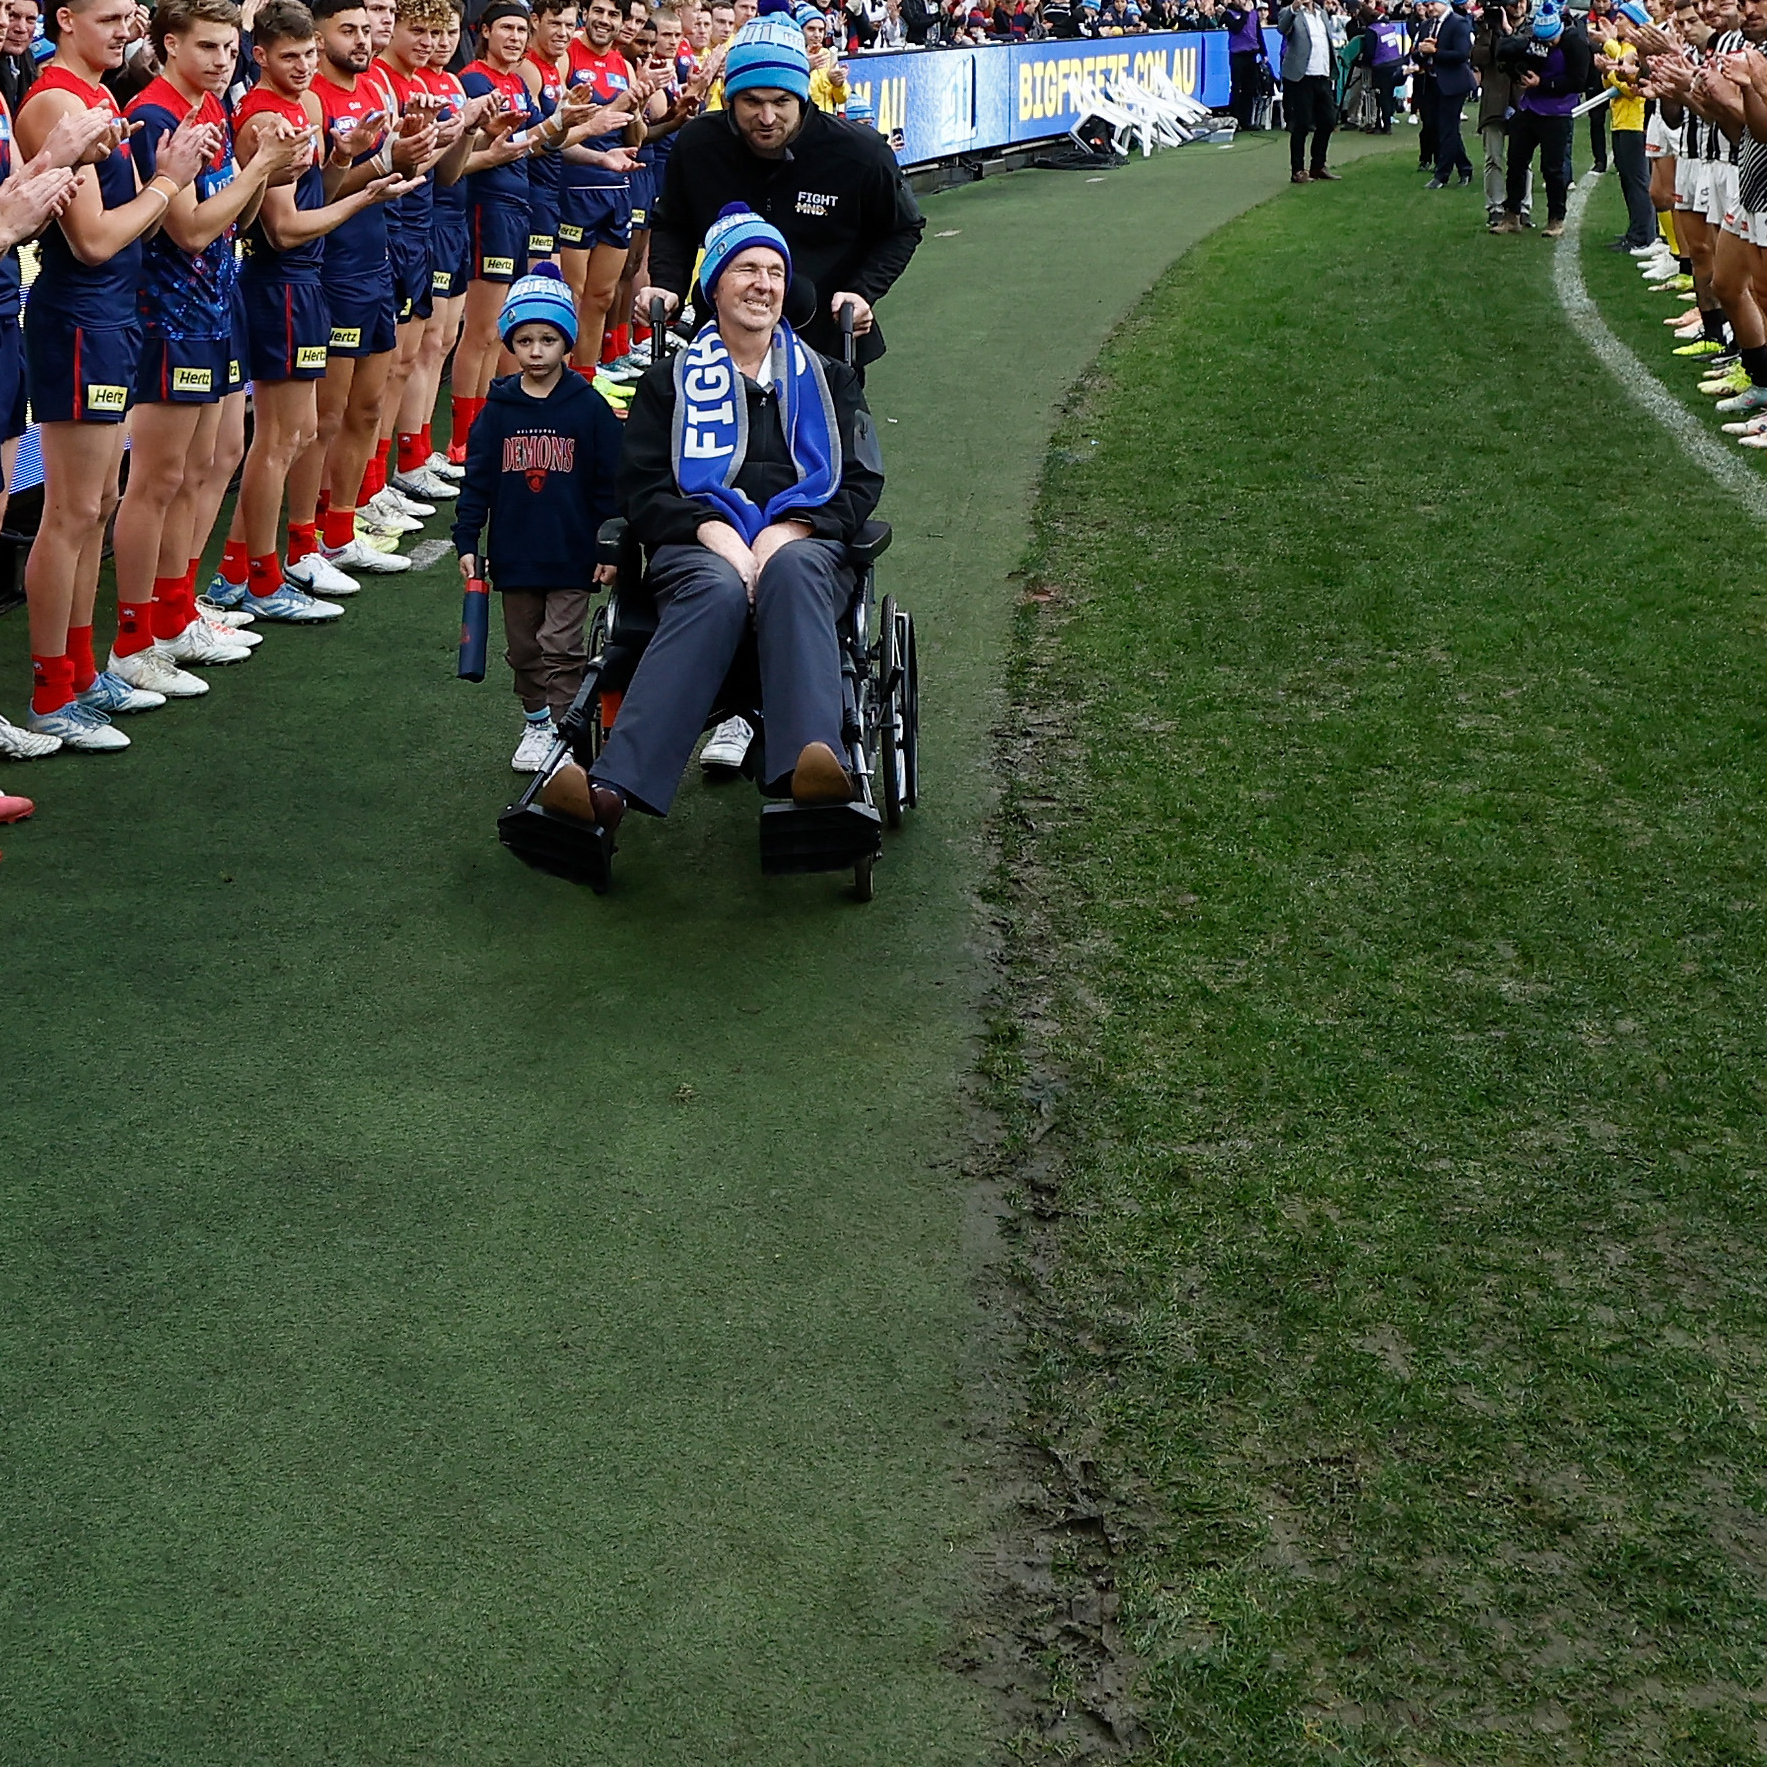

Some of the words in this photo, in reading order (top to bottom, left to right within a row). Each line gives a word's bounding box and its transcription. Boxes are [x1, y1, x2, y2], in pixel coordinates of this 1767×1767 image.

[1018, 47, 1197, 122] BIGFREEZECOMAU
[335, 116, 359, 131] AFL
[797, 191, 839, 207] FIGHT
[560, 226, 580, 239] ertz
[487, 259, 513, 271] Hertz
[501, 435, 575, 474] DEMONS
